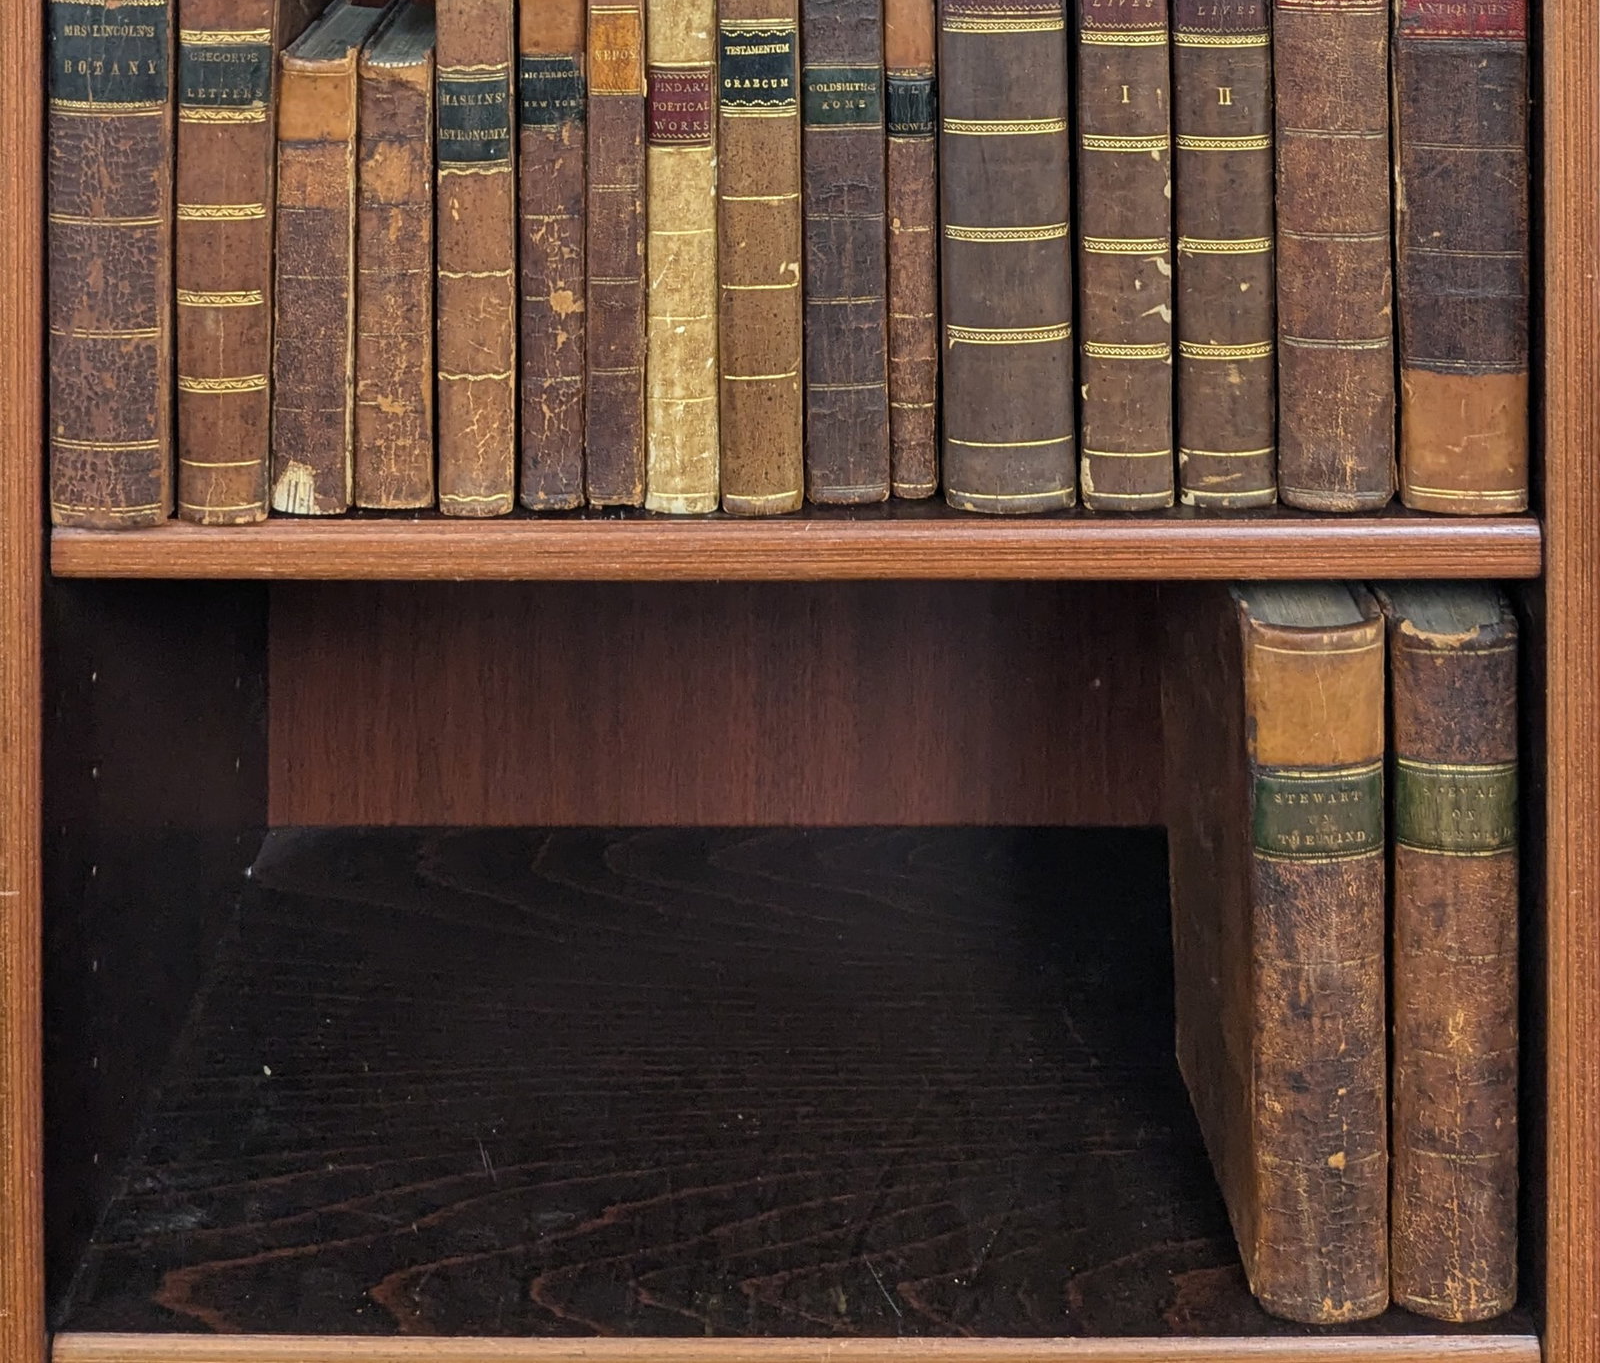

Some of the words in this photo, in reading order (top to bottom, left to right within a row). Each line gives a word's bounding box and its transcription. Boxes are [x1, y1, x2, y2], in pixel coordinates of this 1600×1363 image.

[1197, 5, 1256, 16] LIVES
[595, 46, 637, 61] NEPOS
[725, 43, 790, 56] TESTAMENTUM
[190, 52, 259, 63] GREGORY'S
[64, 59, 157, 76] BOTANY
[654, 82, 709, 93] PINDAR'S
[724, 78, 789, 89] GRAECUM
[187, 88, 263, 98] LETTERS
[1121, 85, 1130, 103] I
[1216, 87, 1233, 105] II
[523, 100, 548, 108] NEW
[652, 101, 710, 112] POETICAL
[821, 99, 867, 110] ROME
[654, 120, 710, 131] WORKS
[1273, 791, 1361, 805] STEWART
[1277, 833, 1315, 847] THE
